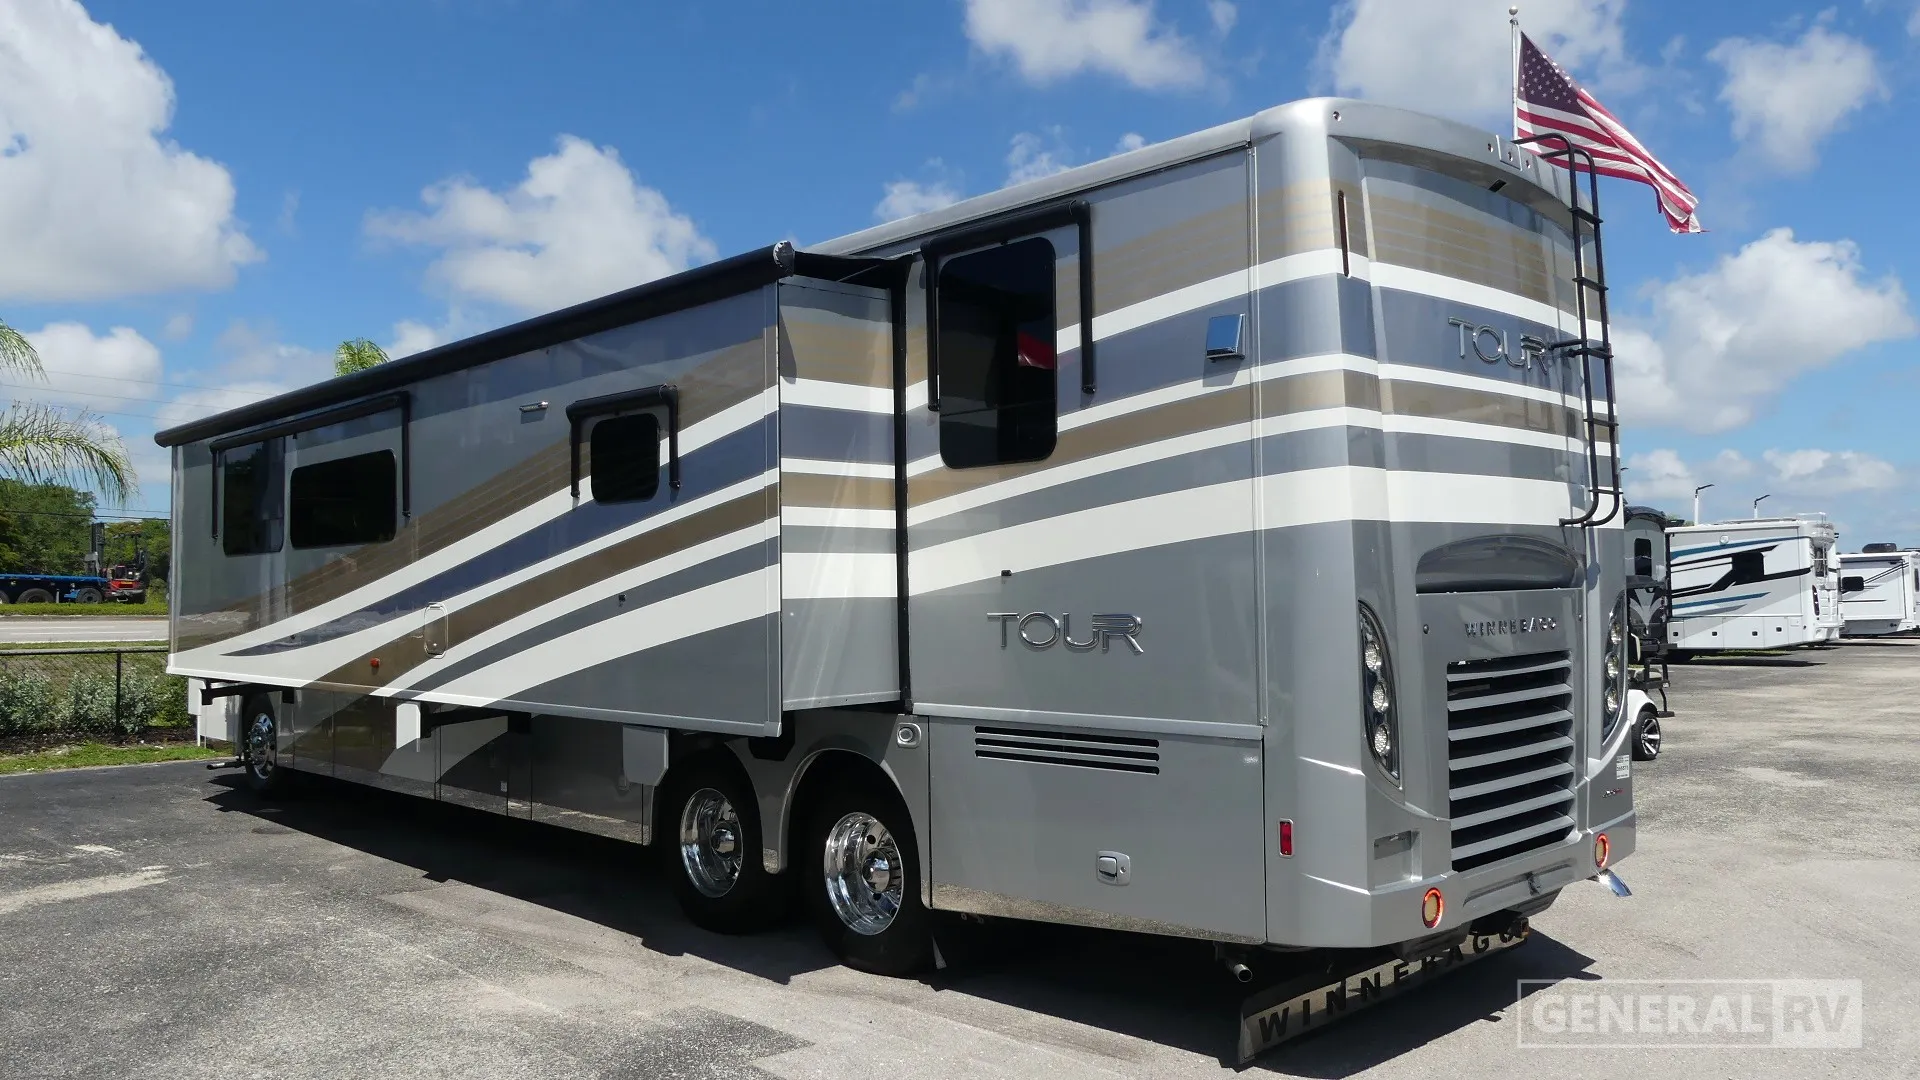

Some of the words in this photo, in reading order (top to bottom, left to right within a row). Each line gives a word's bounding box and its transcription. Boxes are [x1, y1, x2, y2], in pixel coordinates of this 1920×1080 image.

[1448, 316, 1548, 376] TOUR
[986, 611, 1144, 654] TOUR
[1464, 616, 1557, 638] WINNEBAGO
